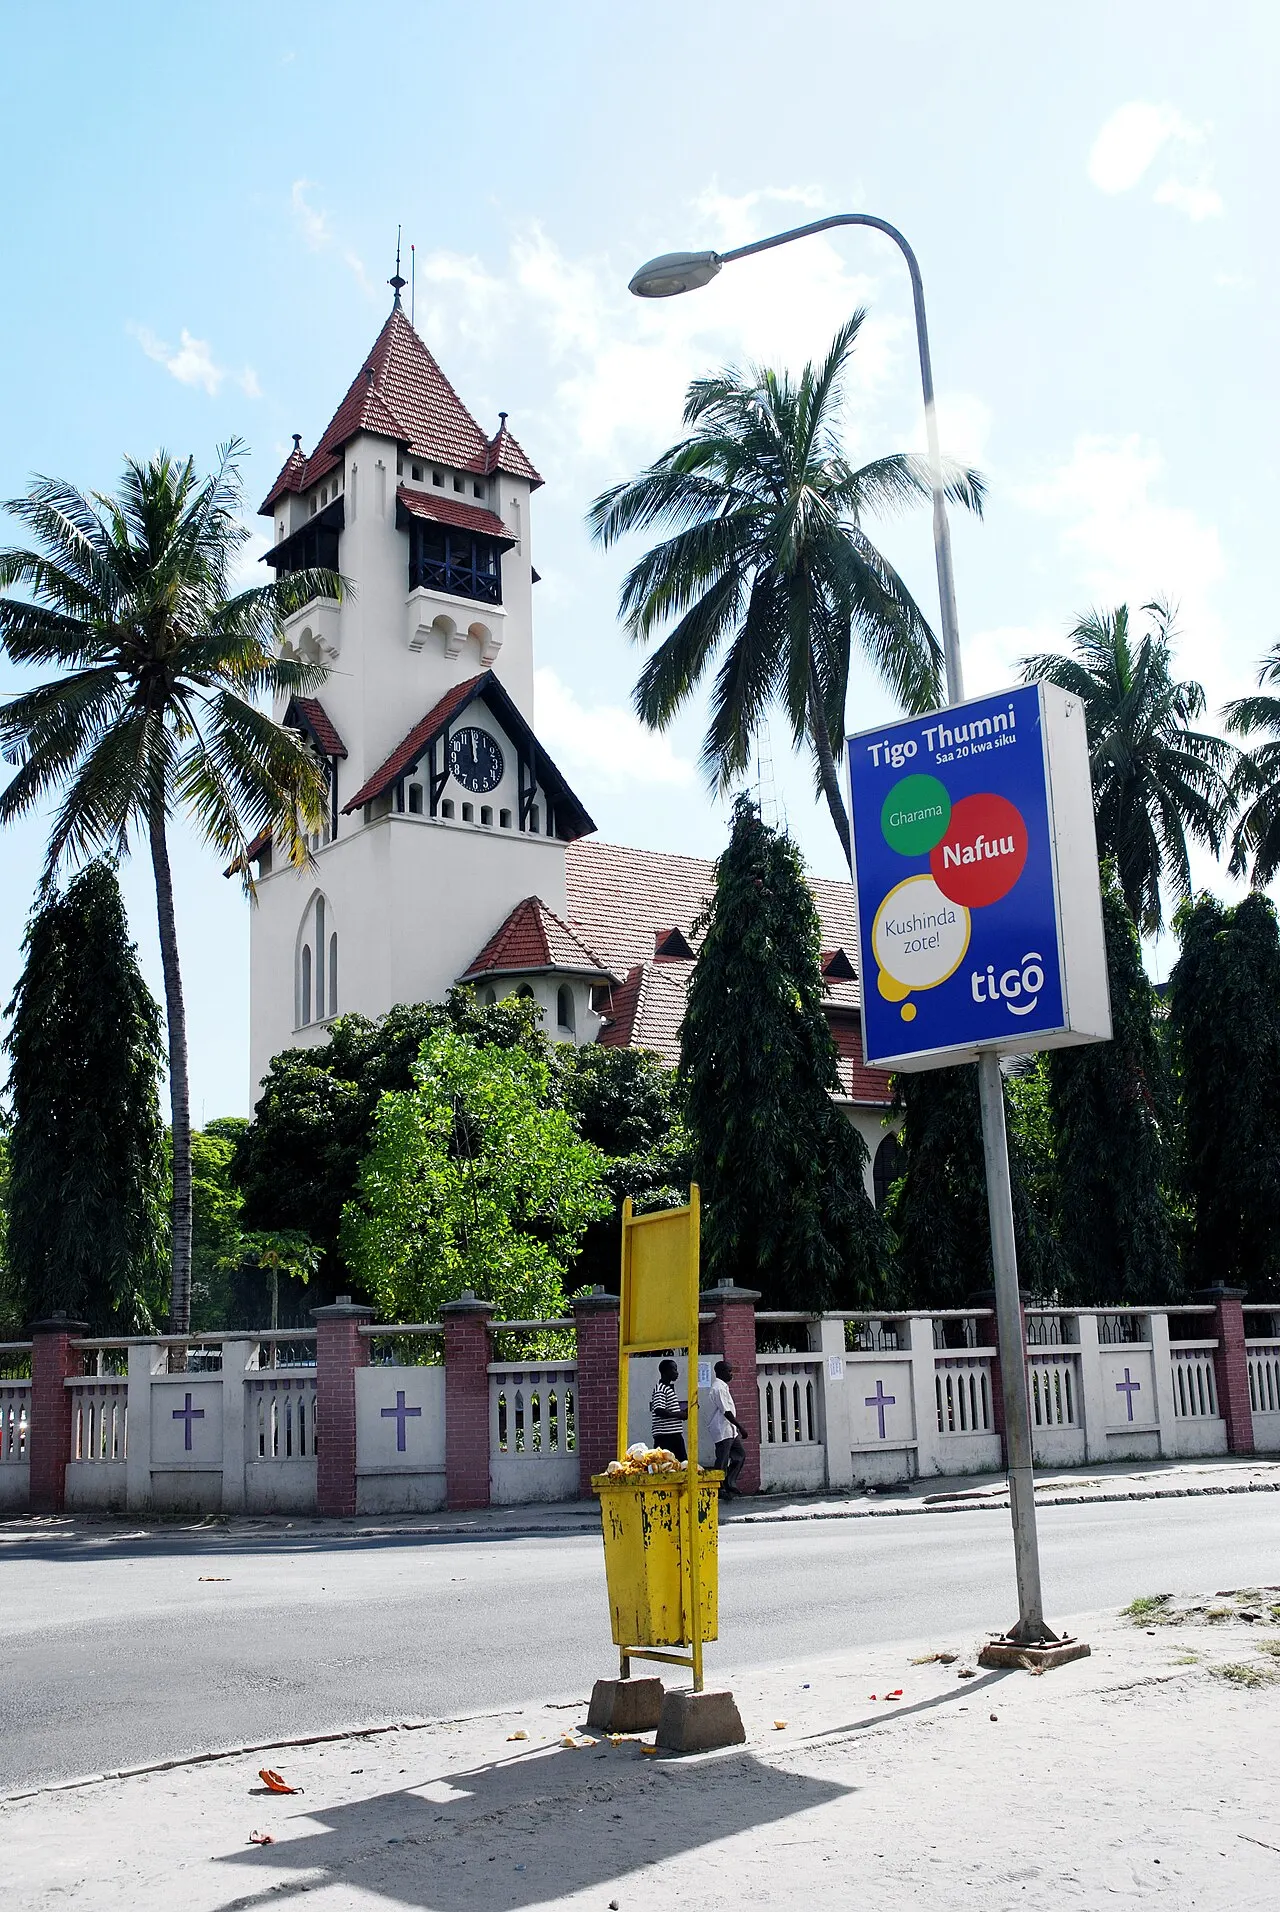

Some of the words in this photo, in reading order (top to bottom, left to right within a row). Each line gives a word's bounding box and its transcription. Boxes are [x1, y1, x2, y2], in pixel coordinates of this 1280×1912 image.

[461, 734, 467, 744] 11
[867, 740, 917, 769] Tigo
[922, 704, 1016, 753] Thumni
[454, 741, 460, 752] 10
[483, 738, 486, 748] 1
[936, 751, 954, 765] Saa
[956, 747, 969, 760] 20
[971, 741, 992, 755] kwa
[994, 732, 1016, 748] siku
[451, 752, 456, 763] 9
[490, 747, 495, 757] 2
[455, 764, 460, 775] 8
[492, 759, 498, 769] 3
[462, 774, 467, 784] 7
[490, 770, 495, 780] 4
[472, 779, 478, 789] 6
[483, 777, 488, 788] 5
[890, 803, 943, 827] Gharama
[943, 834, 1015, 869] Nafuu
[885, 908, 956, 936] Kushinda
[904, 936, 940, 954] zote!
